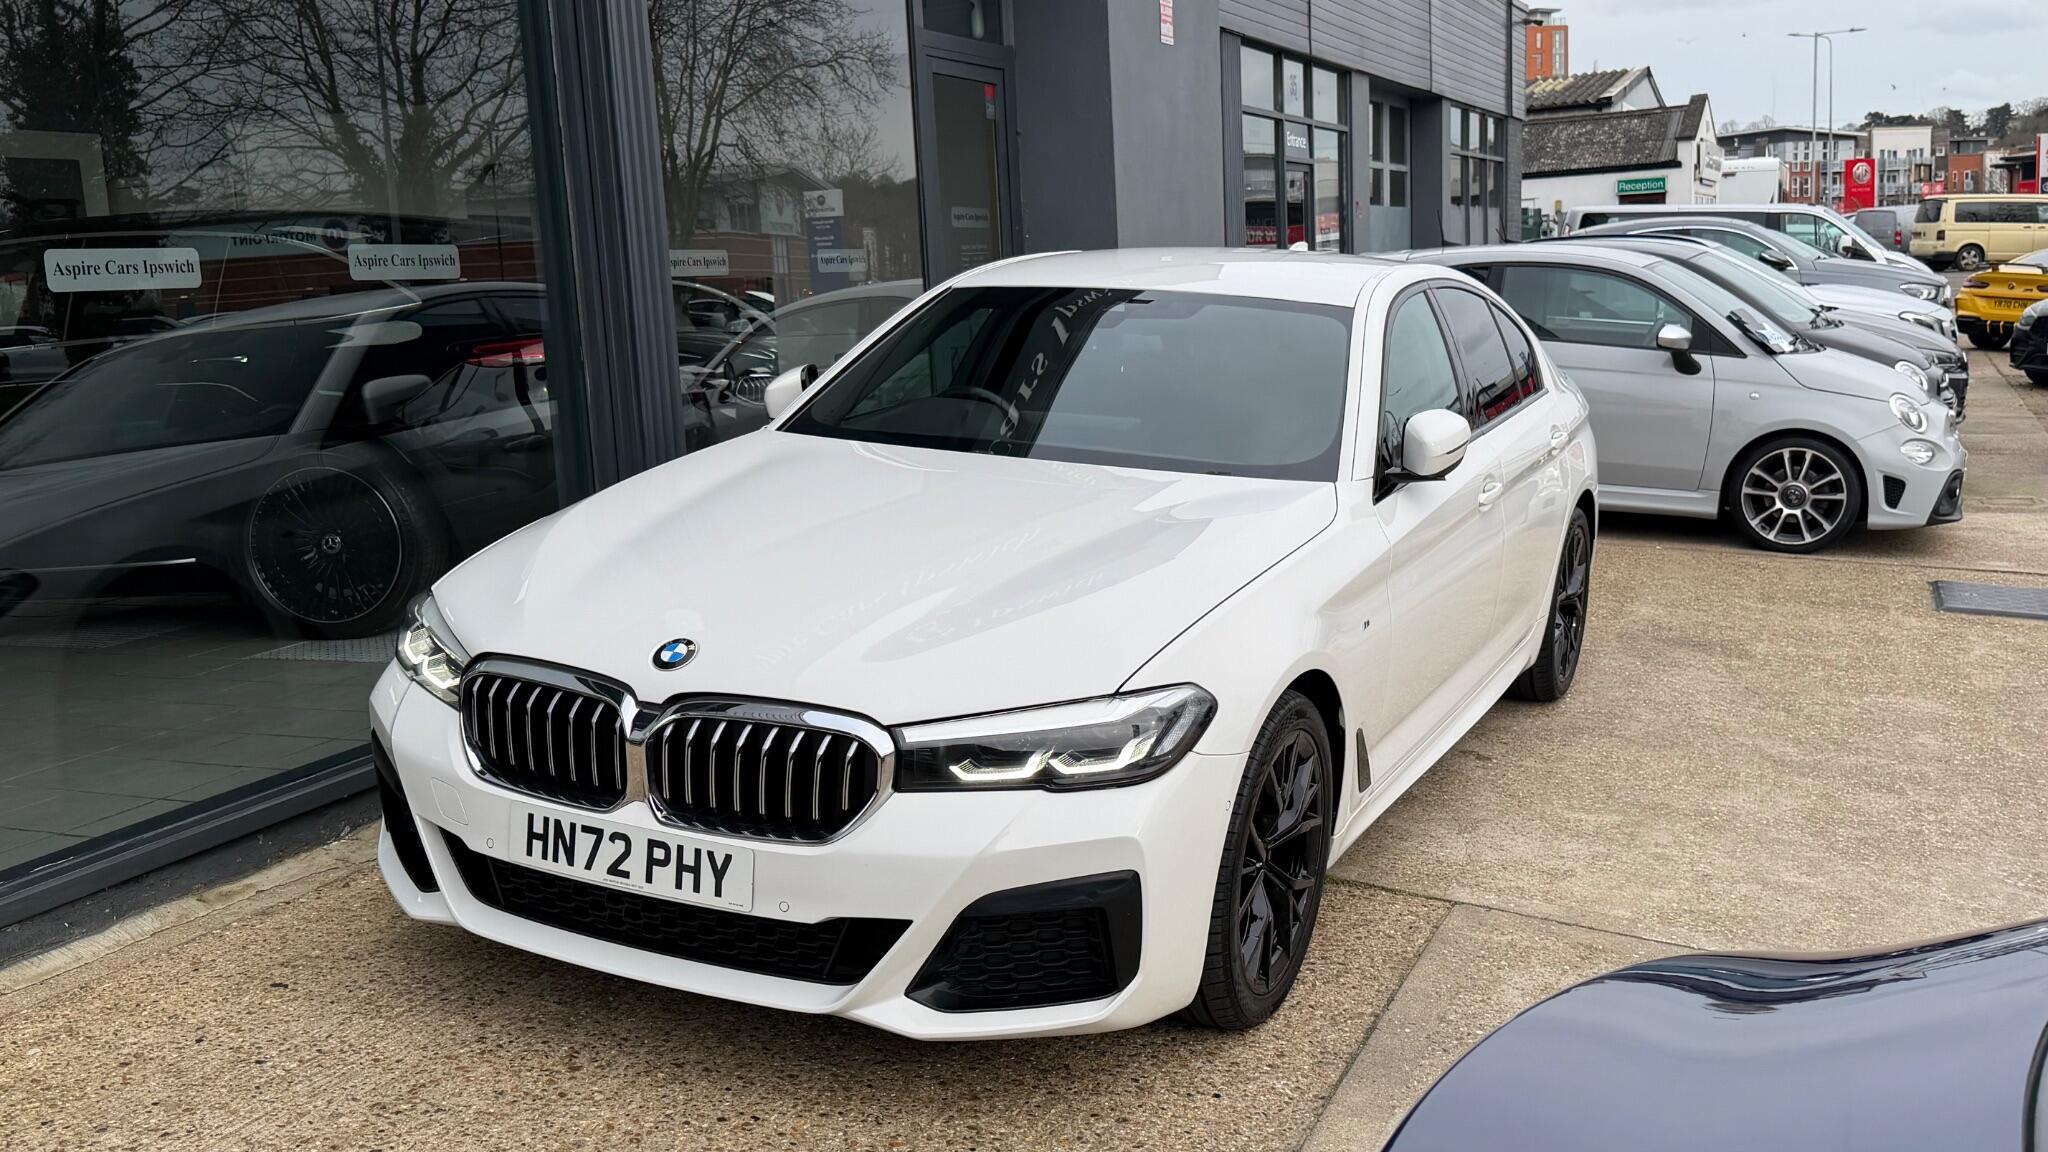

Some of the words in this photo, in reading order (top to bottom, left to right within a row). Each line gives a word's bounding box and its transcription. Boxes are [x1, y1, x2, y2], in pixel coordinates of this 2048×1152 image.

[1286, 130, 1307, 149] Entrance
[1618, 180, 1664, 191] Reception
[354, 255, 389, 270] Aspire
[390, 254, 416, 267] Cars
[418, 254, 456, 270] Ipswich
[670, 257, 686, 269] spire
[687, 256, 702, 267] Cars
[703, 256, 727, 268] Ipswich
[836, 256, 848, 265] Cars
[53, 261, 101, 280] Aspire
[105, 260, 139, 275] Cars
[142, 259, 195, 278] Ipswich
[526, 812, 633, 880] HN72
[645, 838, 733, 898] PHY
